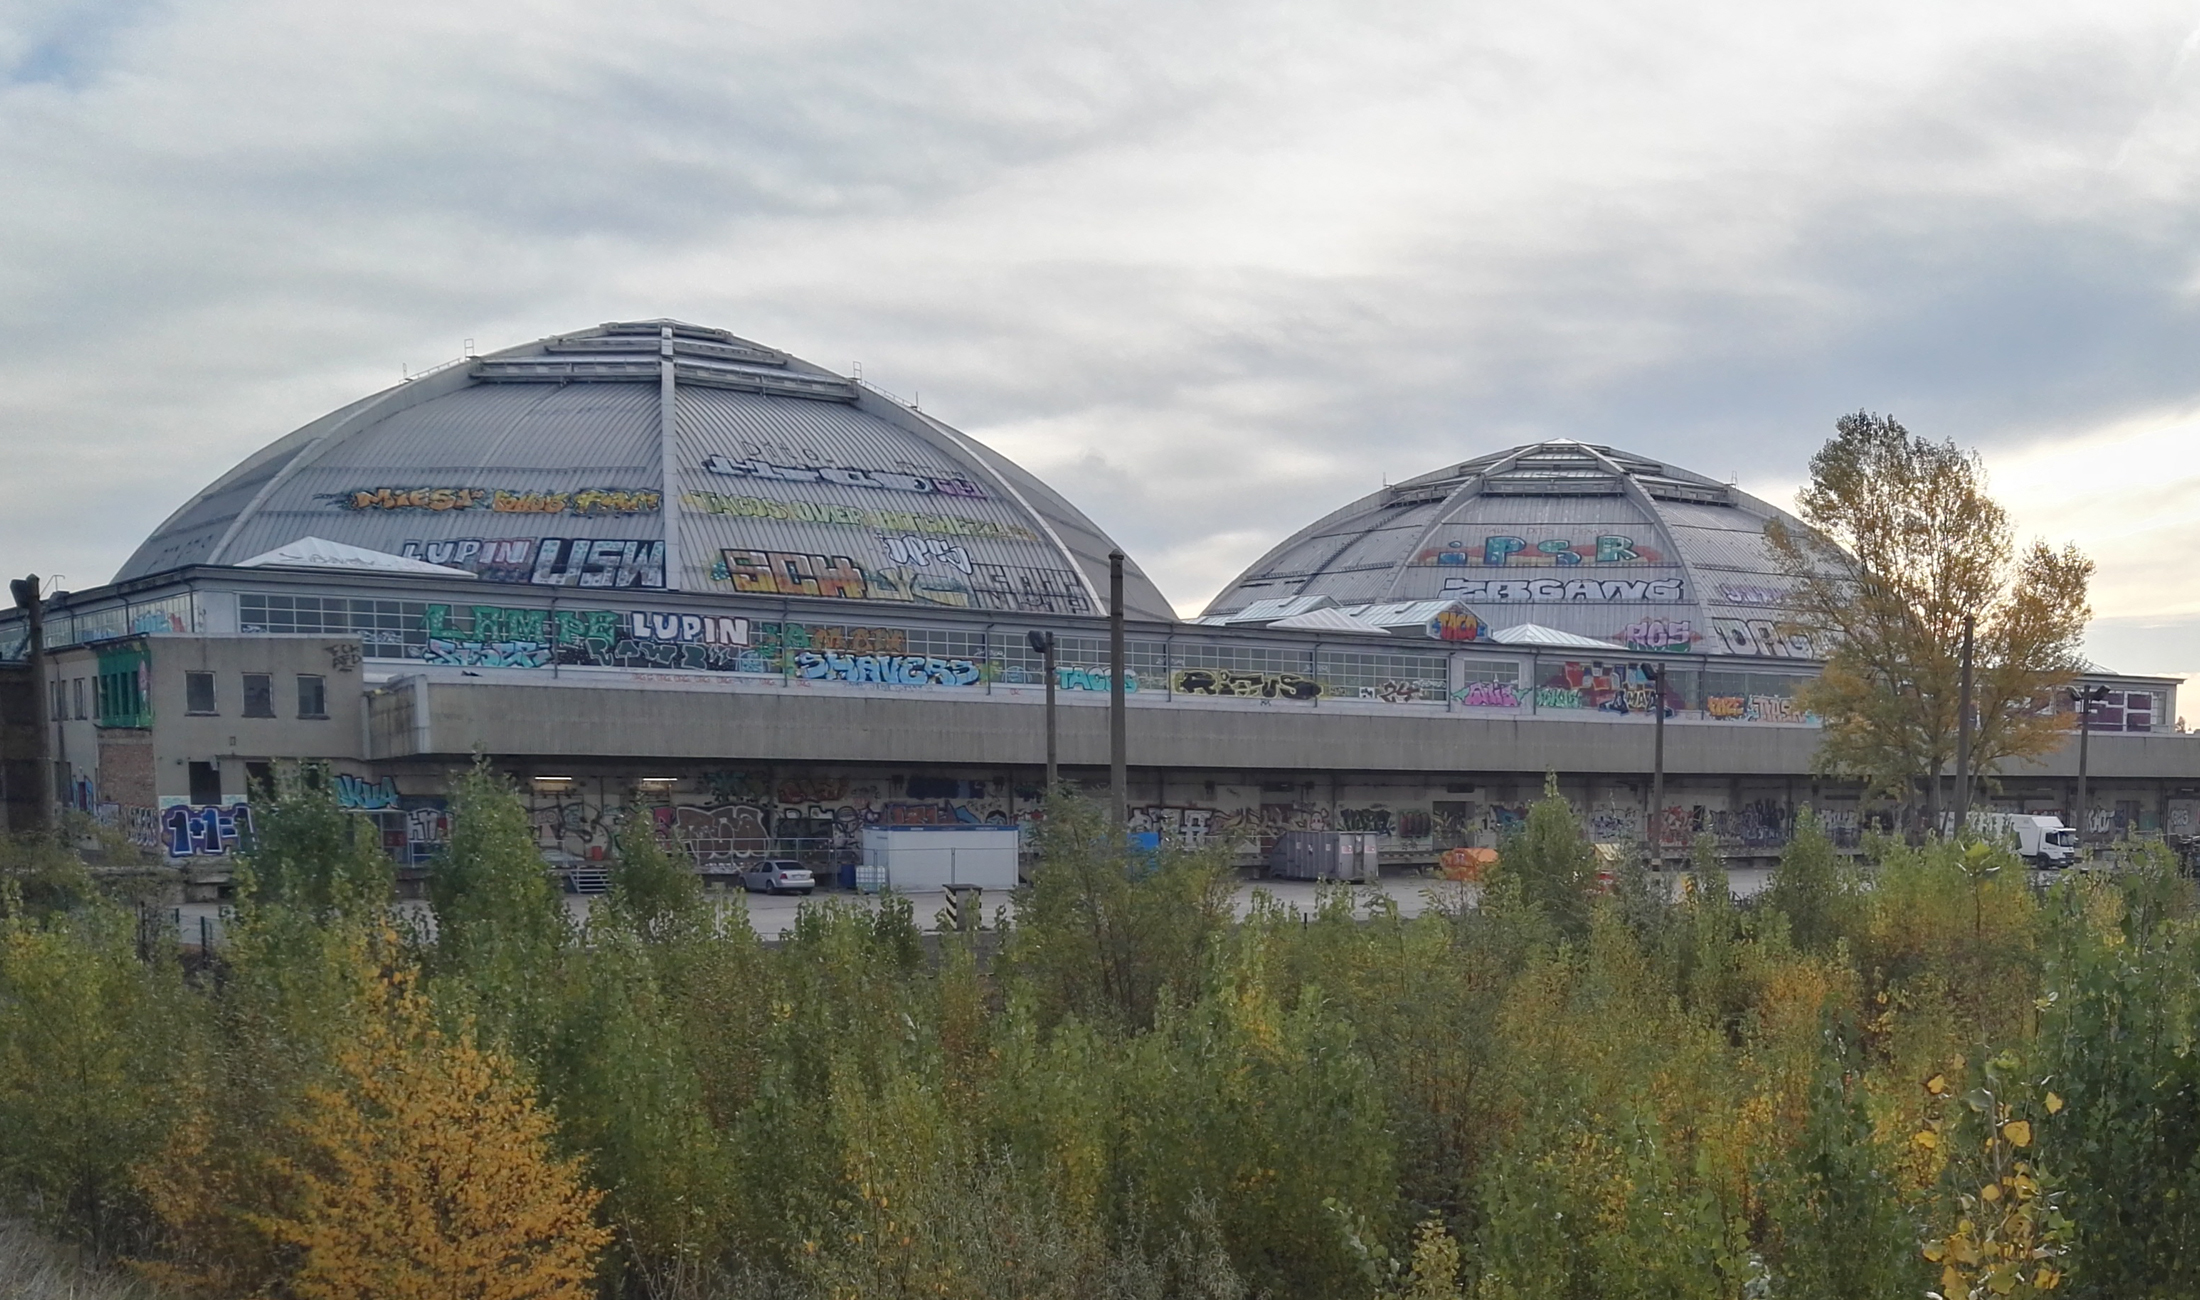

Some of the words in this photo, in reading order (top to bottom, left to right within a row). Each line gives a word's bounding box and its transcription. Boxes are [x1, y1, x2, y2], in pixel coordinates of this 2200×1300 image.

[690, 490, 789, 520] TACOS
[789, 500, 866, 526] OVER
[402, 536, 534, 565] LUPIN
[530, 537, 667, 588] USW
[419, 603, 619, 645] LAMPE
[631, 611, 751, 647] LUPIN
[1437, 610, 1478, 641] TACO
[794, 651, 982, 687] SHAVERS
